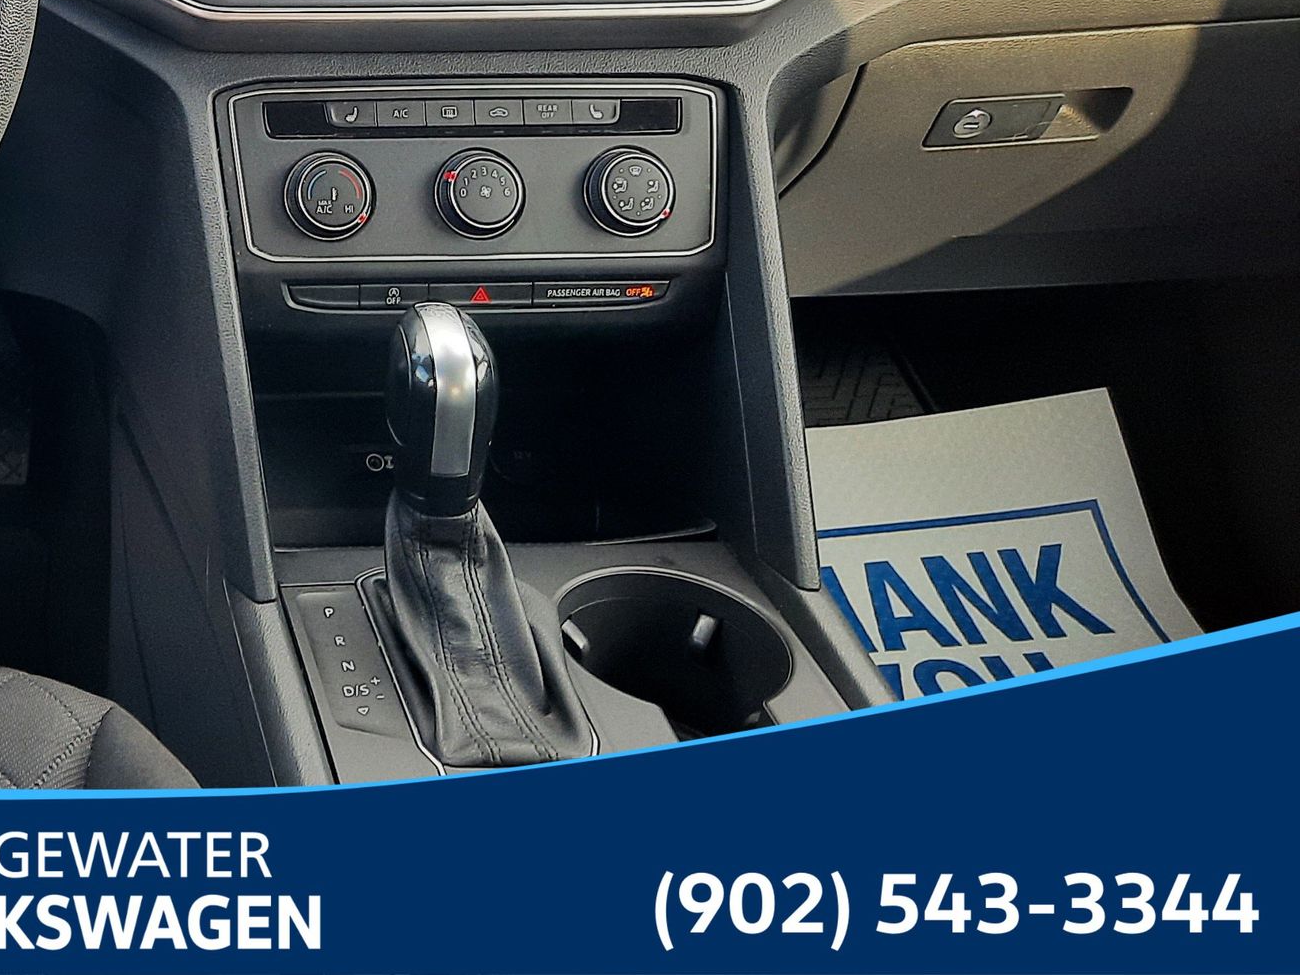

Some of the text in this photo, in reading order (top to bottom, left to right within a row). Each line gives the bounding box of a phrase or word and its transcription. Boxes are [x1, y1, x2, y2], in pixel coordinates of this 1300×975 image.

[537, 104, 558, 112] REAR
[393, 109, 409, 118] A/C
[471, 169, 477, 179] 2
[481, 166, 487, 176] 3
[491, 169, 498, 178] 4
[500, 176, 506, 186] 5
[460, 186, 467, 197] 0
[504, 187, 511, 196] 6
[316, 205, 333, 214] A/C
[344, 205, 354, 214] HI
[547, 288, 641, 298] PASSENGER AIR BAG OFF
[386, 296, 401, 305] OFF
[820, 544, 1115, 653] ANK
[325, 608, 334, 617] P
[335, 636, 346, 647] R
[342, 661, 355, 672] N
[343, 685, 370, 697] D/S
